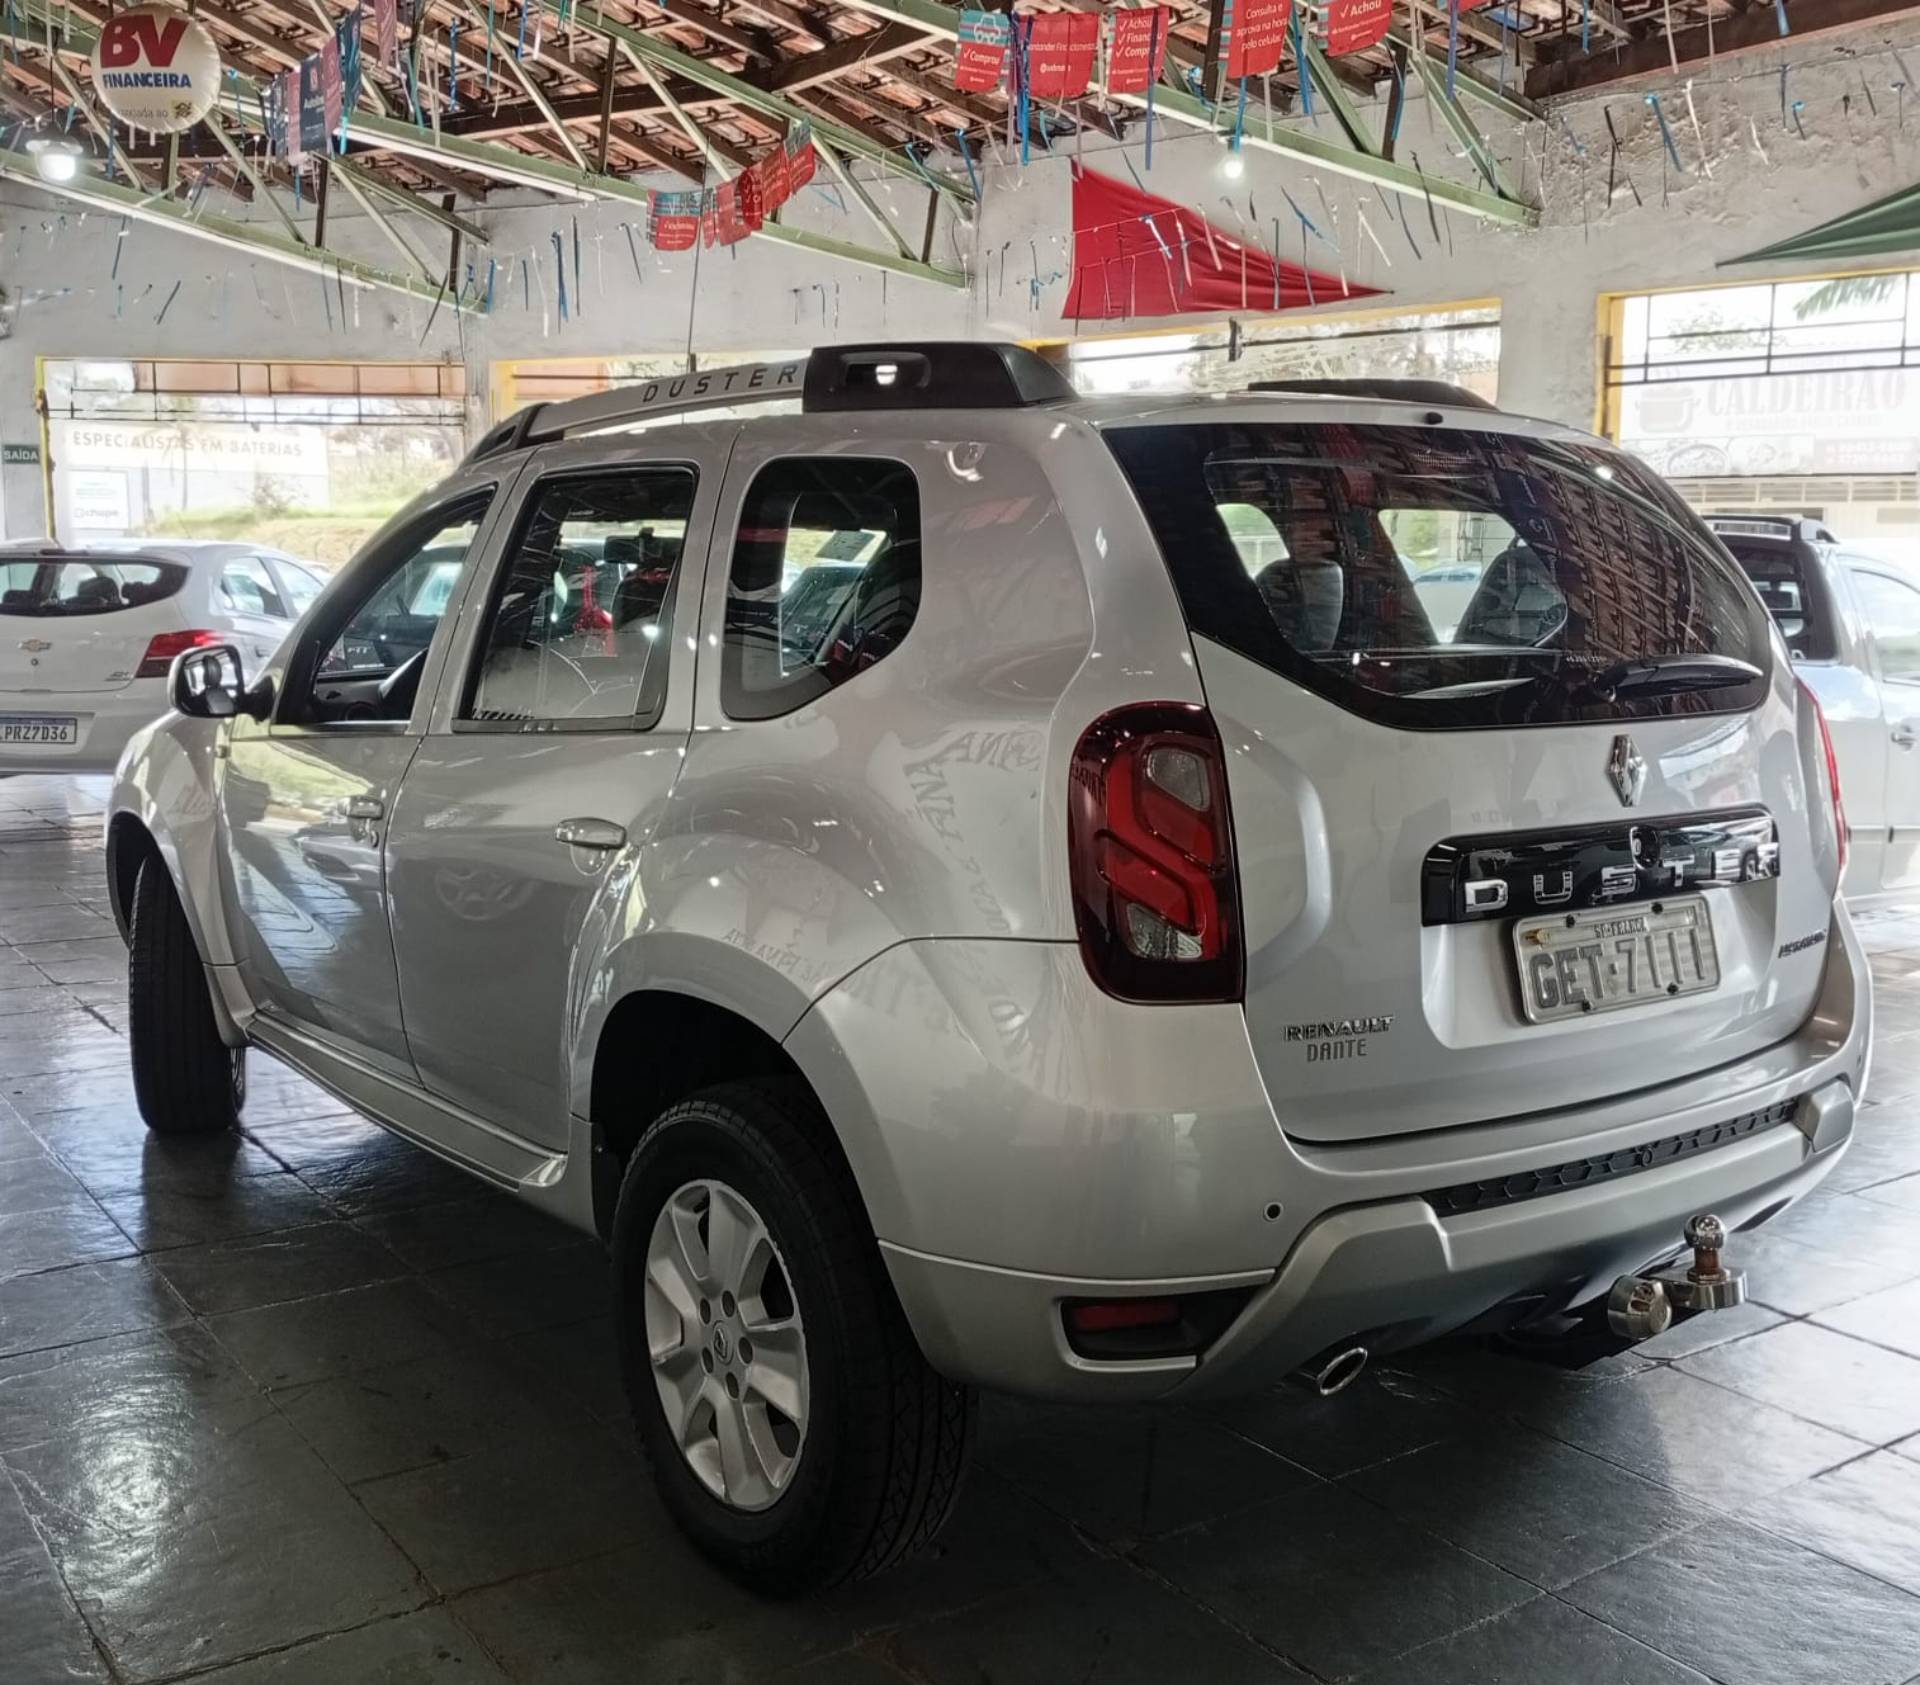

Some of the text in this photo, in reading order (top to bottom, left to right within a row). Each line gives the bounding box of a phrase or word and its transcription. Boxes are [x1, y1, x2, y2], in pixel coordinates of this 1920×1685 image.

[1246, 3, 1283, 19] Consulta e
[1350, 0, 1382, 16] Achou
[1236, 25, 1261, 38] aprova
[1261, 22, 1272, 31] na
[100, 14, 190, 68] BV
[1241, 38, 1258, 52] pelo
[102, 72, 191, 88] FINANCEIRA
[642, 364, 798, 403] DUSTER
[73, 431, 302, 456] ESPECIALISTAS EM BATERIAS
[5, 726, 68, 740] PRZ7D36
[1465, 842, 1779, 913] DUSTER
[1285, 1014, 1393, 1041] RENAULT
[1307, 1038, 1367, 1062] DANTE
